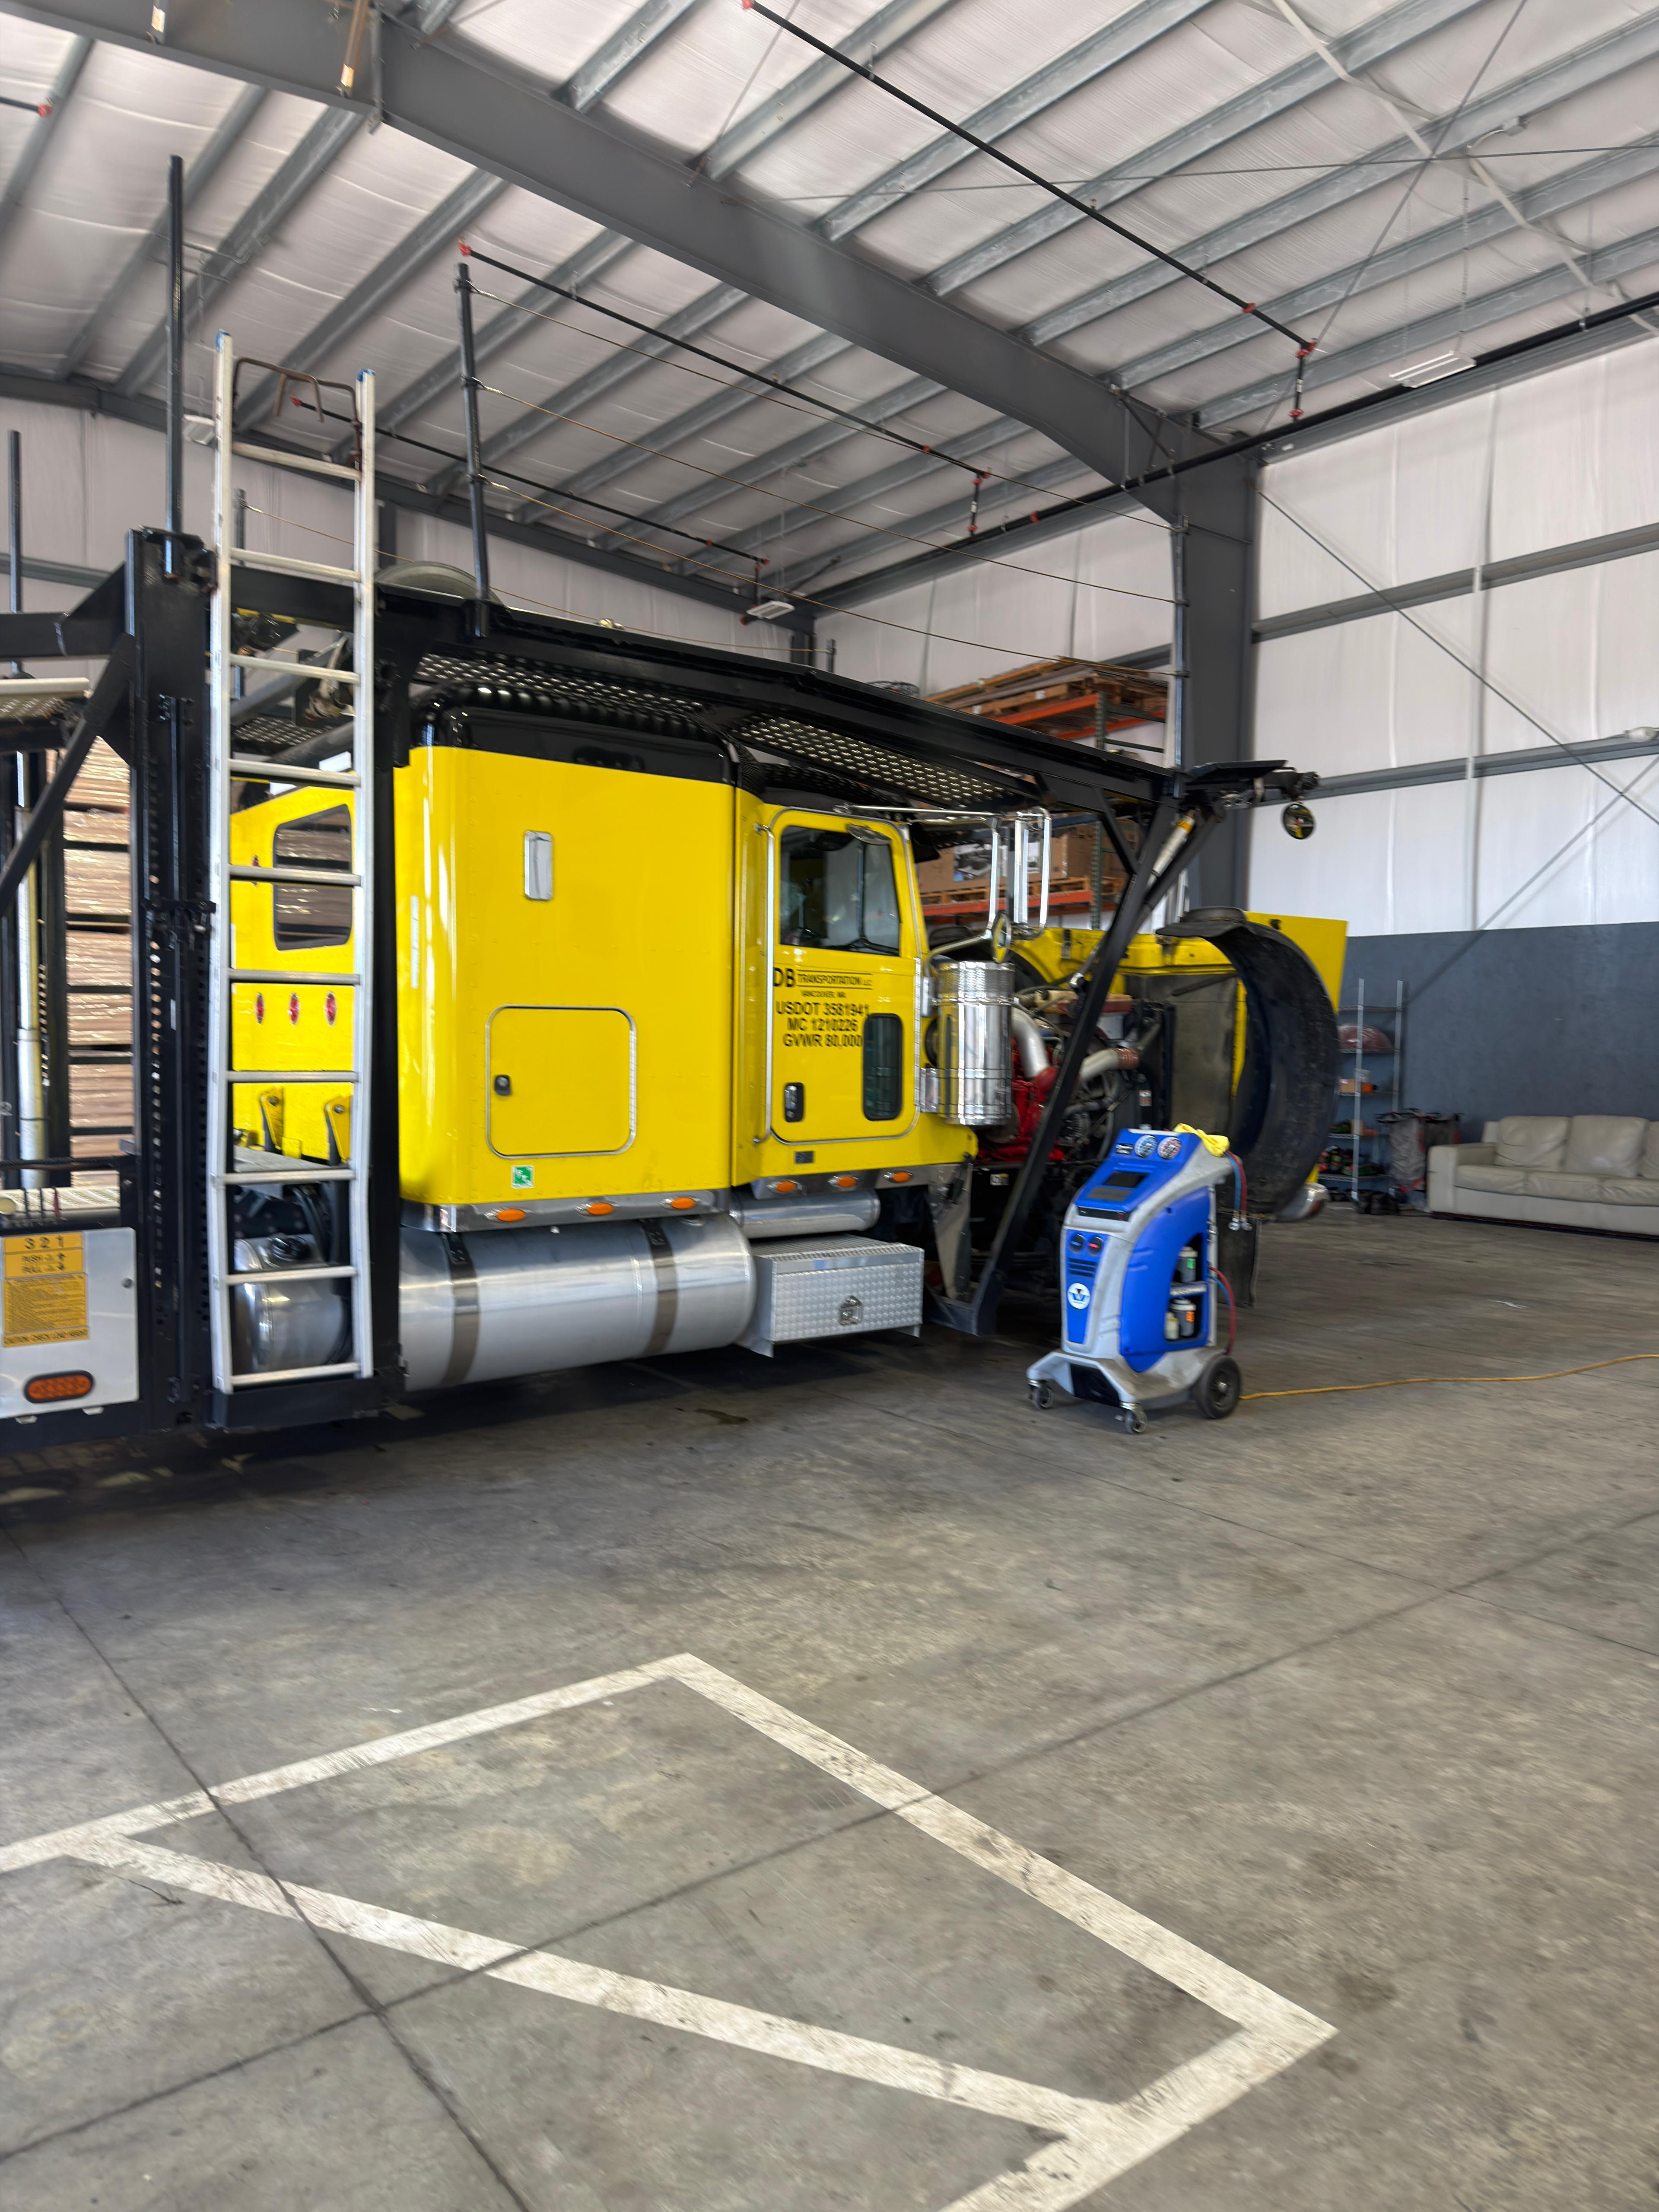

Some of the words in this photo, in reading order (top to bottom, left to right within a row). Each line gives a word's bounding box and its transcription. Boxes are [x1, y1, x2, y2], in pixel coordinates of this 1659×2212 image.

[773, 967, 796, 988] DB
[798, 974, 861, 985] TRANSPORTATION
[775, 1001, 820, 1015] USDOT
[823, 1003, 869, 1016] 3581941
[787, 1017, 807, 1031] MC
[811, 1018, 858, 1032] 1210226
[782, 1033, 823, 1047] GVWR
[39, 1237, 50, 1249] 2
[56, 1235, 64, 1248] 1
